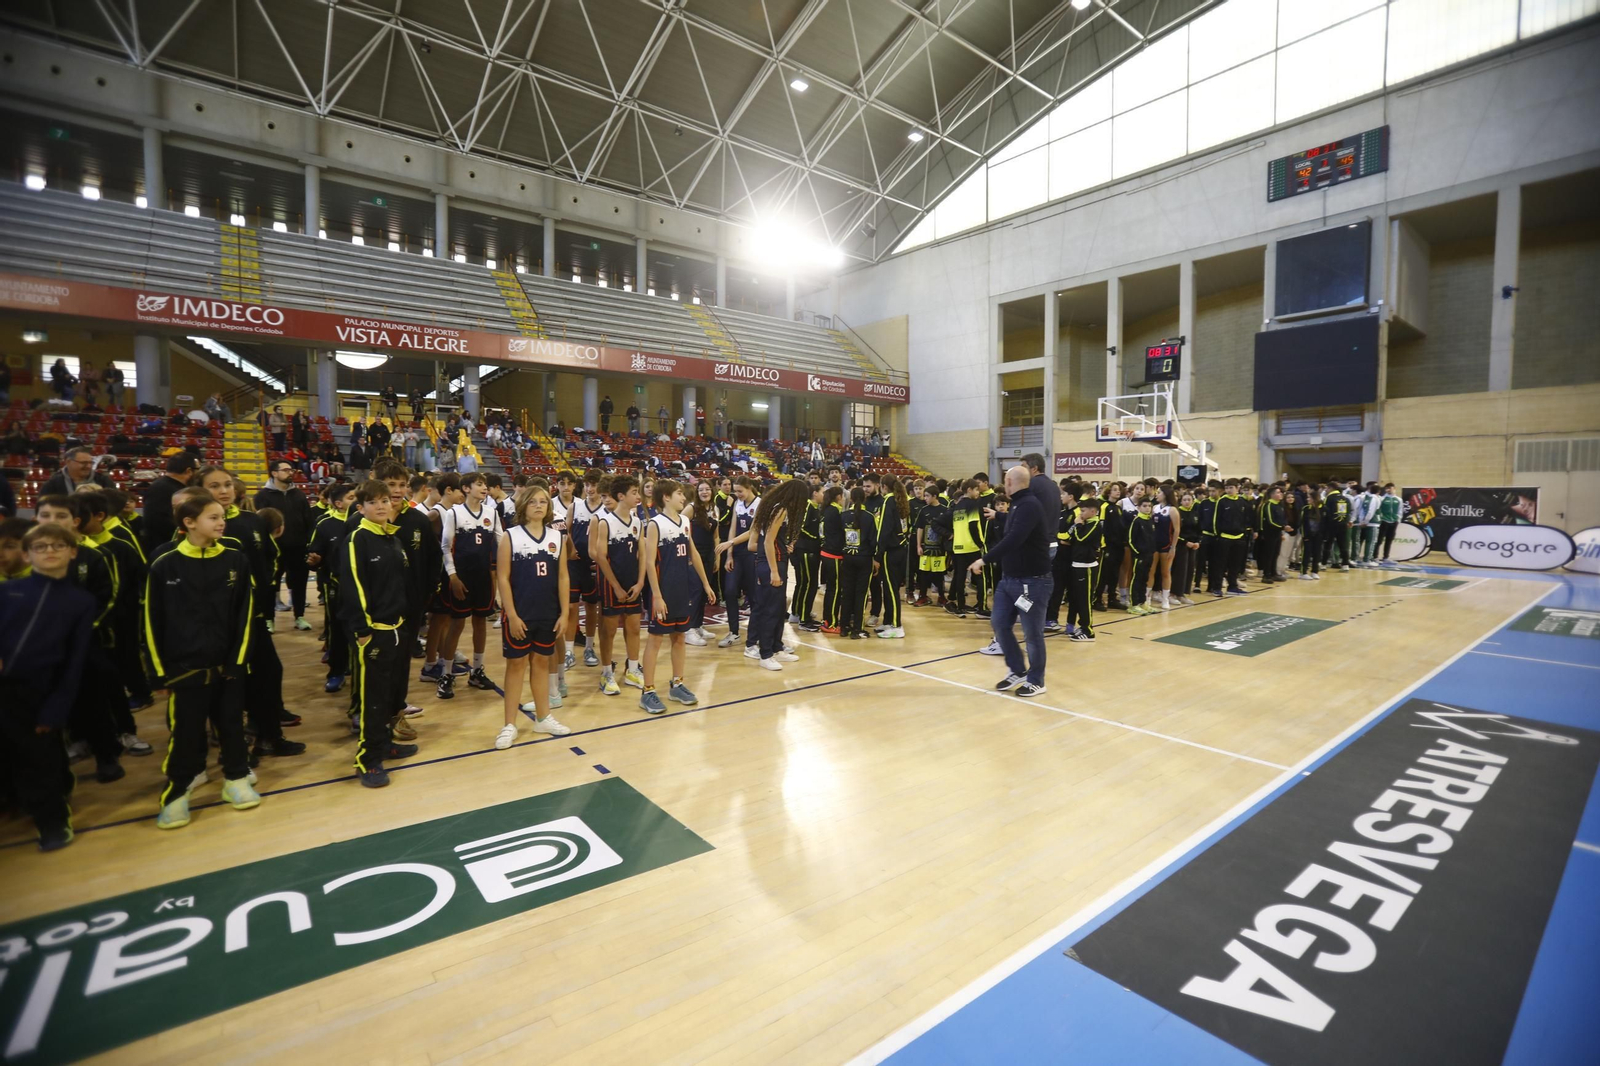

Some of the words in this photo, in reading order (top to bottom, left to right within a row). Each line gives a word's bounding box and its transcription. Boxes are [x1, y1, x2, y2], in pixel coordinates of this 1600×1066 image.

[1295, 161, 1312, 169] LOCAL
[1299, 167, 1312, 177] 42
[174, 297, 285, 326] IMDECO
[137, 314, 170, 323] Instituto
[172, 318, 208, 328] Municipal
[221, 323, 254, 332] Deportes
[254, 326, 284, 335] Córdoba
[344, 318, 380, 328] PALACIO
[381, 322, 422, 333] MUNICIPAL
[424, 327, 459, 337] DEPORTES
[336, 325, 392, 346] VISTA
[398, 333, 469, 353] ALEGRE
[530, 340, 598, 360] IMDECO
[647, 356, 677, 366] AYUNTAMIENTO
[1162, 358, 1172, 372] 0
[730, 364, 779, 381] IMDECO
[873, 384, 906, 397] IMDECO
[1068, 456, 1110, 466] IMDECO
[1440, 504, 1485, 517] Smilke
[475, 533, 482, 545] 6
[627, 541, 633, 553] 7
[676, 543, 687, 557] 30
[535, 561, 547, 576] 13
[1180, 738, 1509, 1032] ATRESVEGA
[154, 895, 195, 914] by
[0, 861, 457, 1058] Cual
